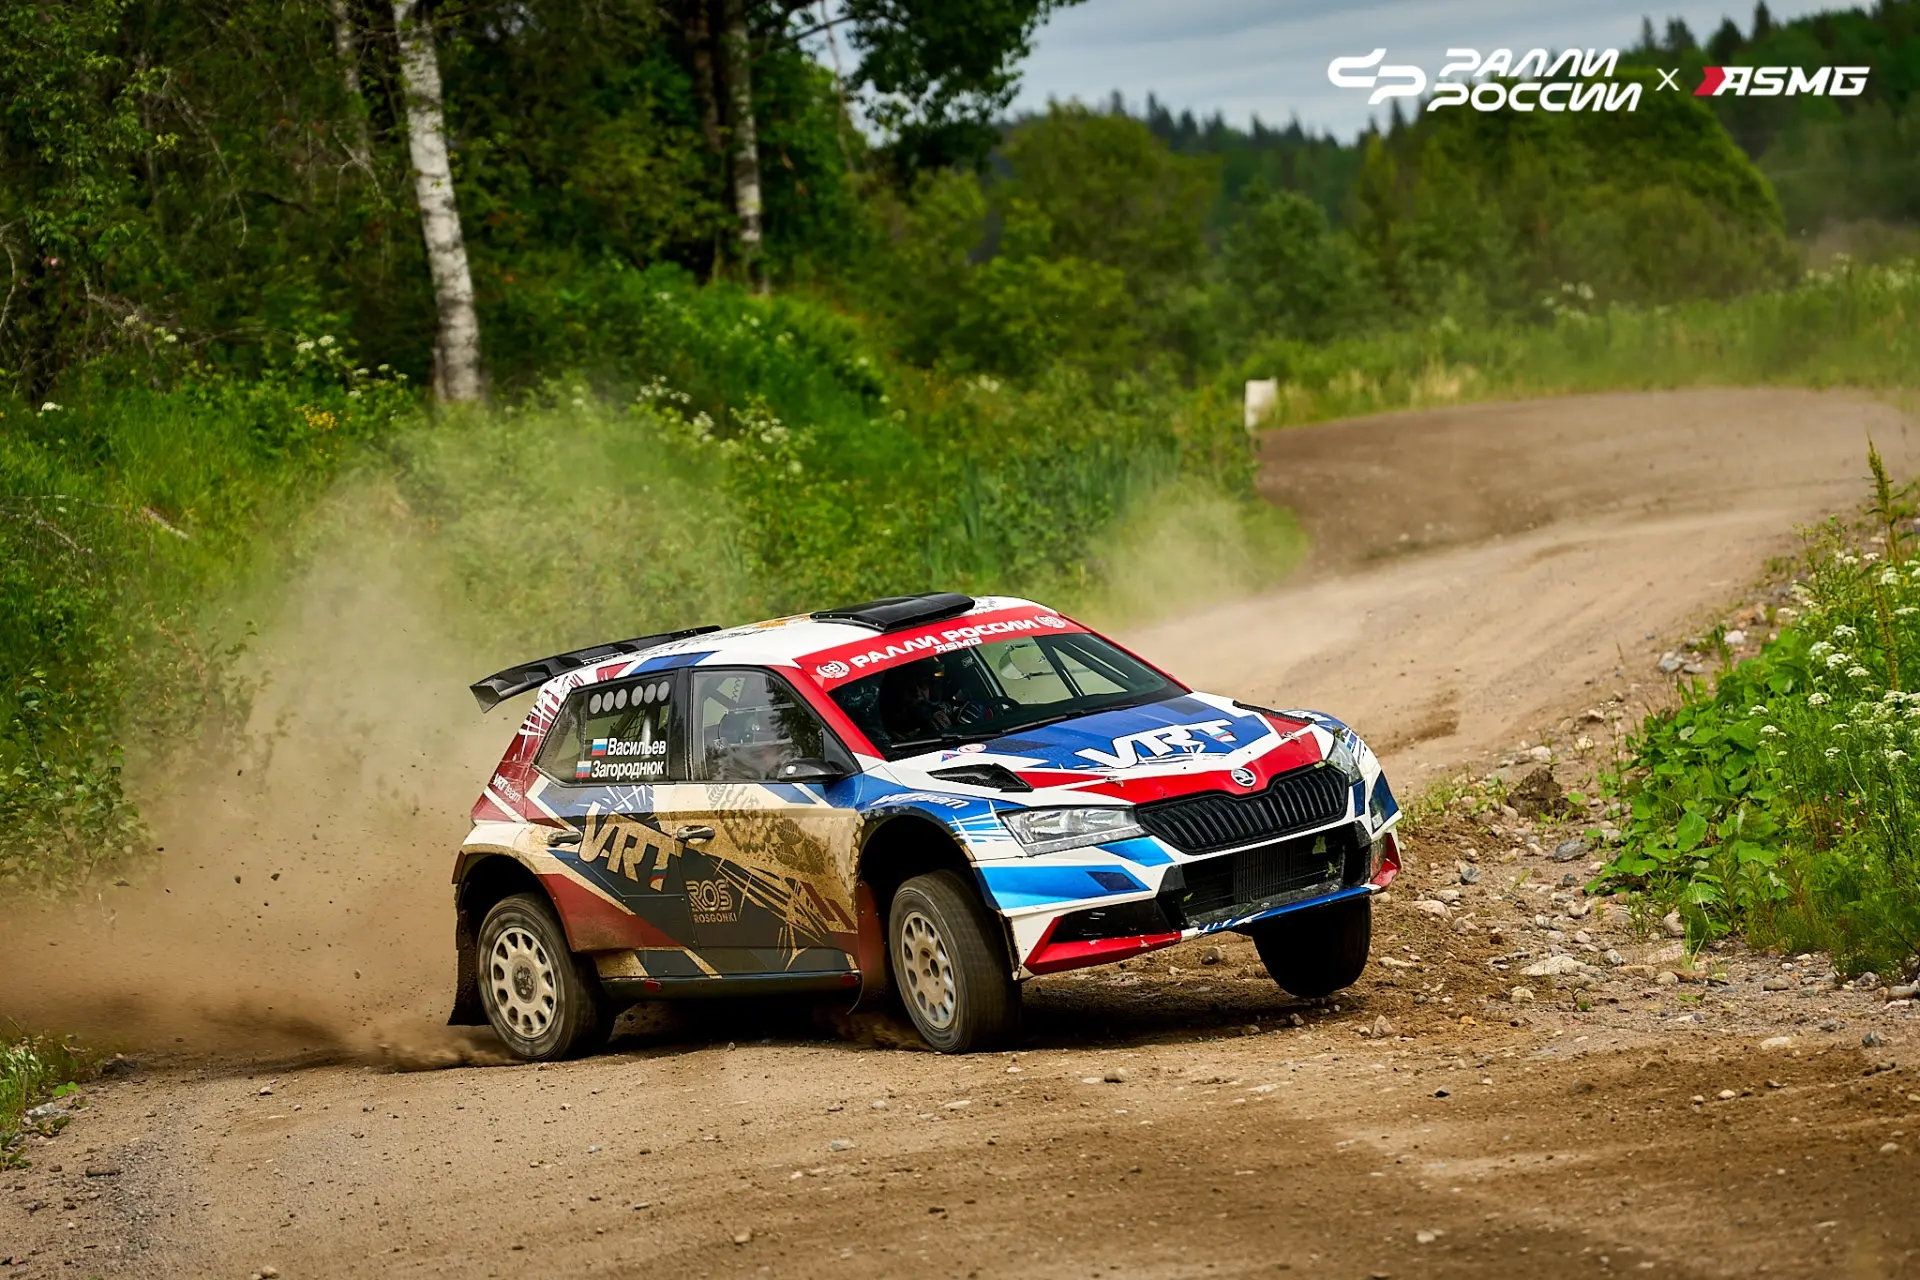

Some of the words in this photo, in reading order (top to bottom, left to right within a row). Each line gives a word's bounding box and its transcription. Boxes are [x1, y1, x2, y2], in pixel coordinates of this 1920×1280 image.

[850, 635, 939, 668] РАЛЛИ
[941, 619, 1040, 642] РОССИИ
[935, 637, 983, 653] ASMG
[607, 738, 667, 755] Васильев
[1073, 719, 1237, 769] VRT
[591, 760, 664, 780] Загороднюк
[579, 801, 686, 892] VRT
[693, 912, 737, 924] ROSGONKI
